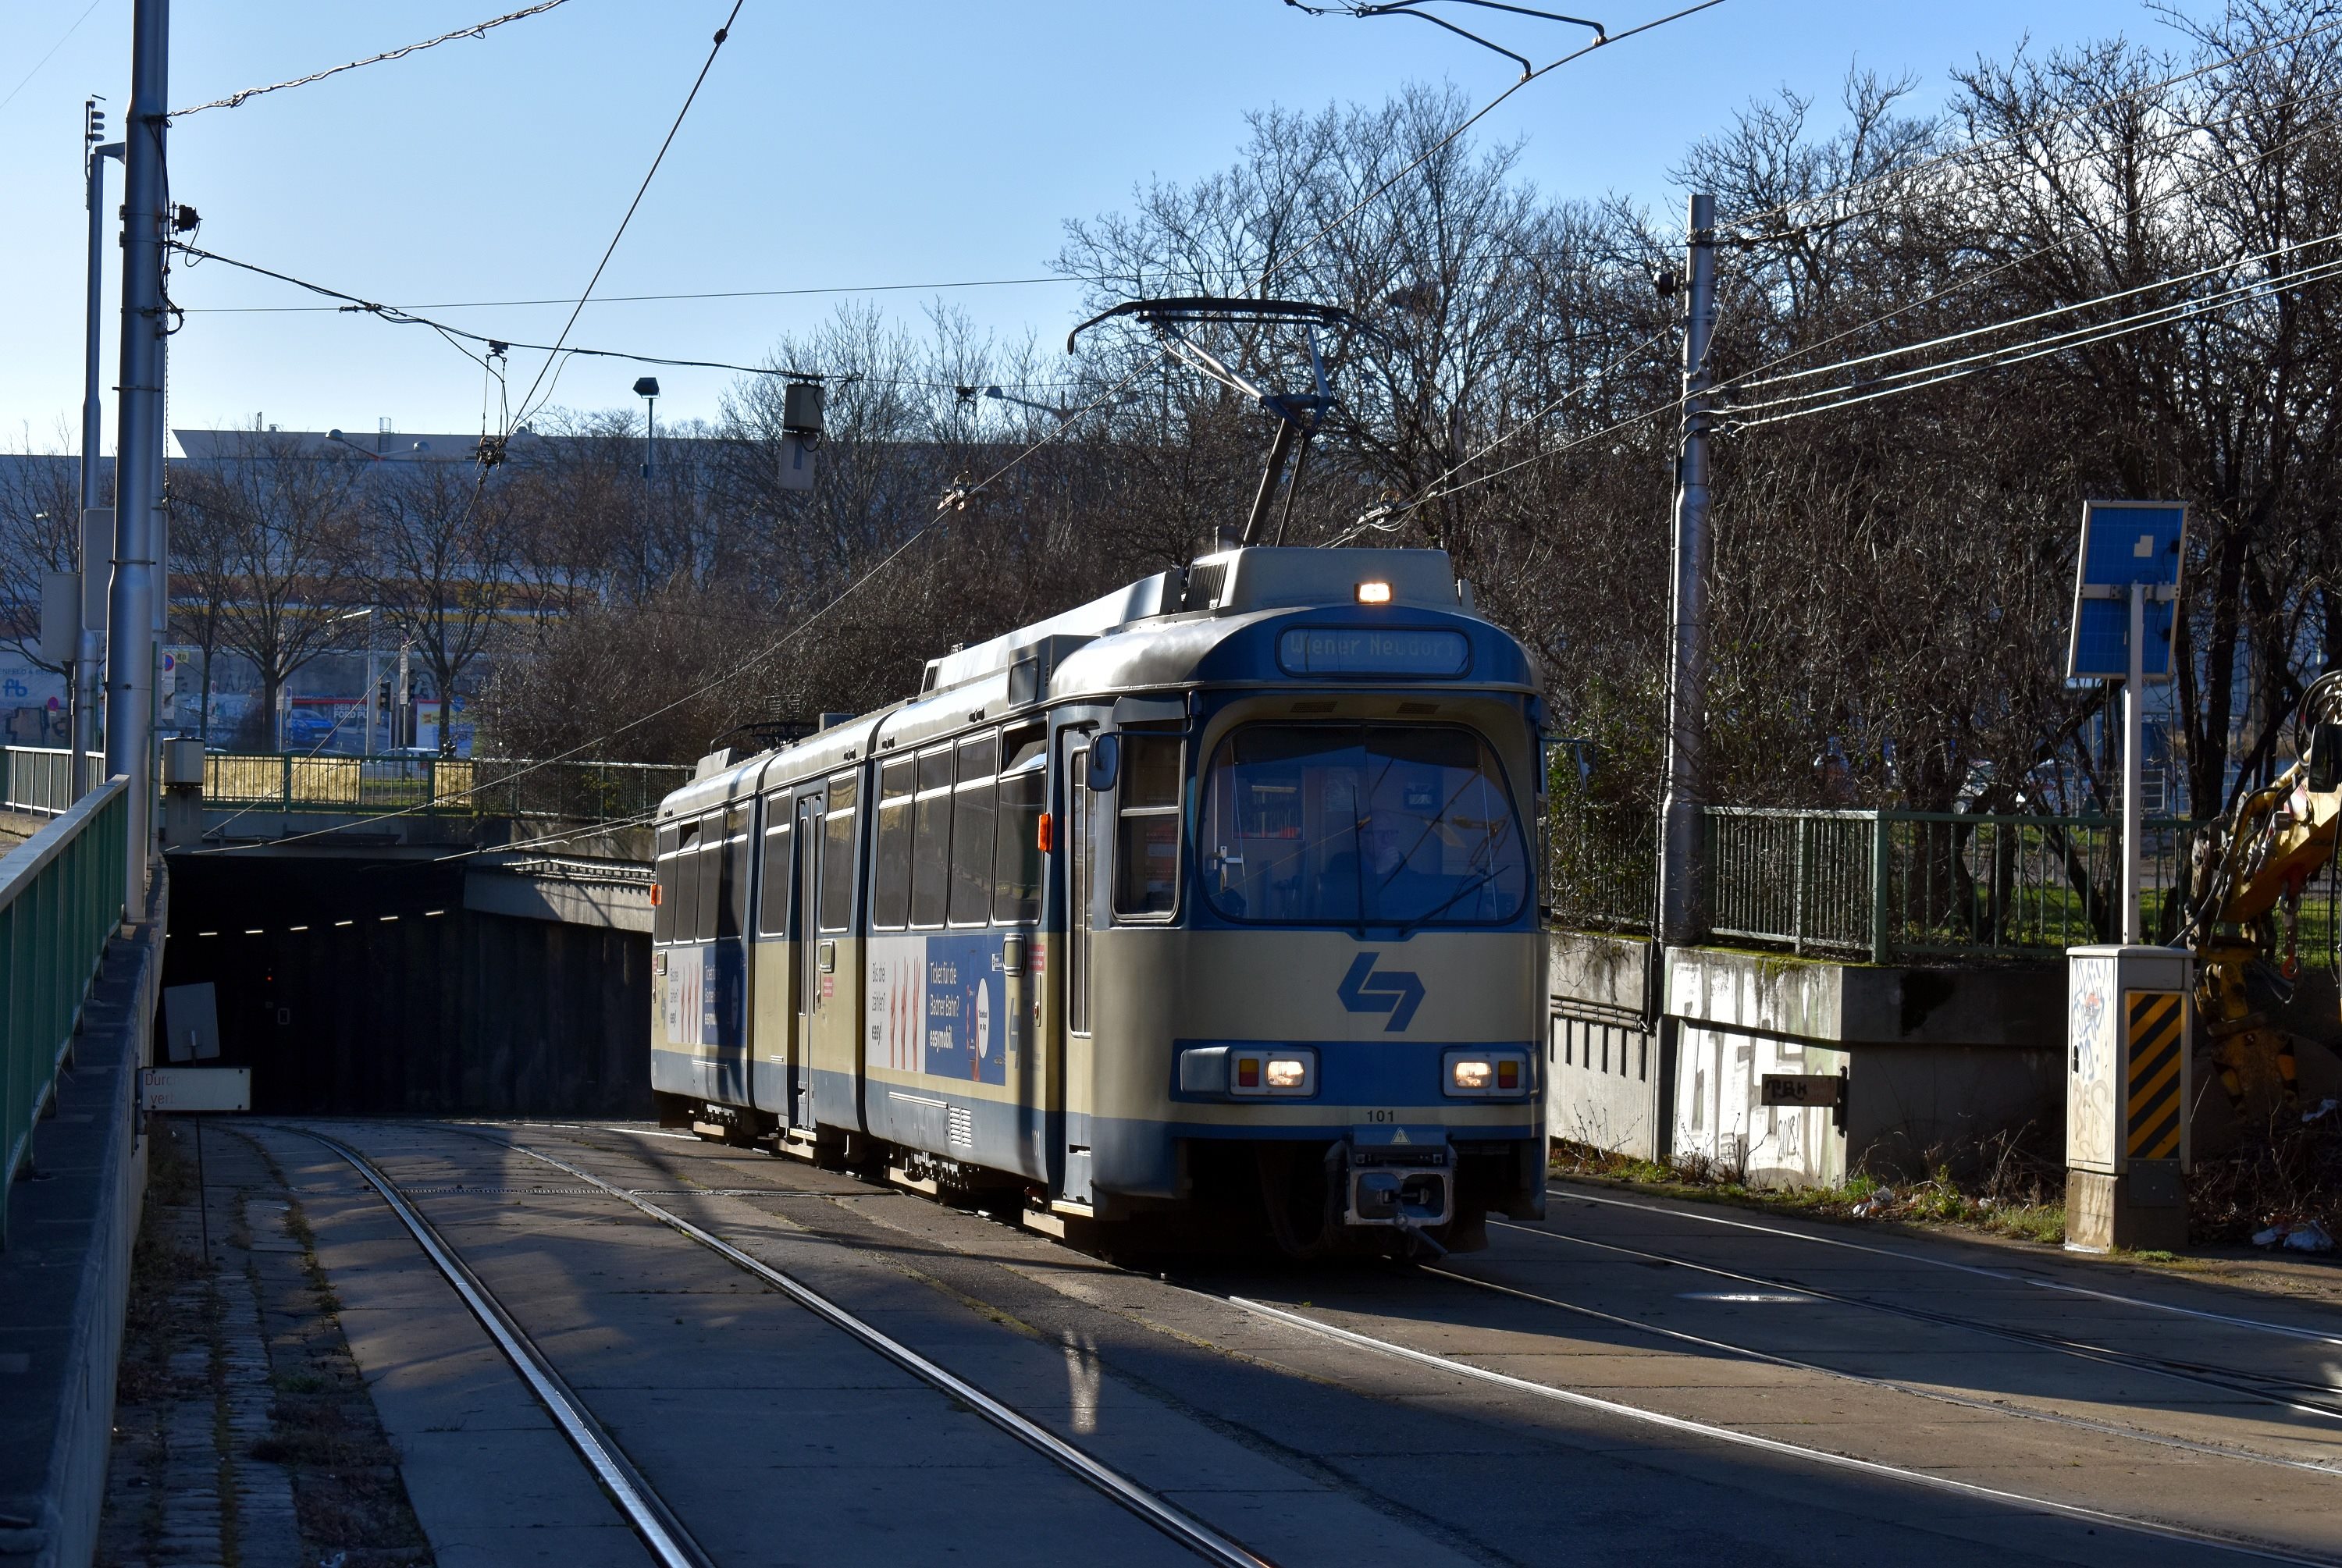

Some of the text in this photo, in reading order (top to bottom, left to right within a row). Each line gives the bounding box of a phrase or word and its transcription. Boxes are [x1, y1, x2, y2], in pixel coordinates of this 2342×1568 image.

[1290, 632, 1458, 656] Wiener Neudorf
[930, 961, 943, 985] Ticket
[872, 991, 886, 1012] zählen?
[930, 993, 959, 1018] Badner Bahn?
[871, 1021, 882, 1046] easy!
[929, 1024, 953, 1054] easymobil.
[1367, 1110, 1393, 1122] 101
[1031, 1129, 1041, 1159] 101
